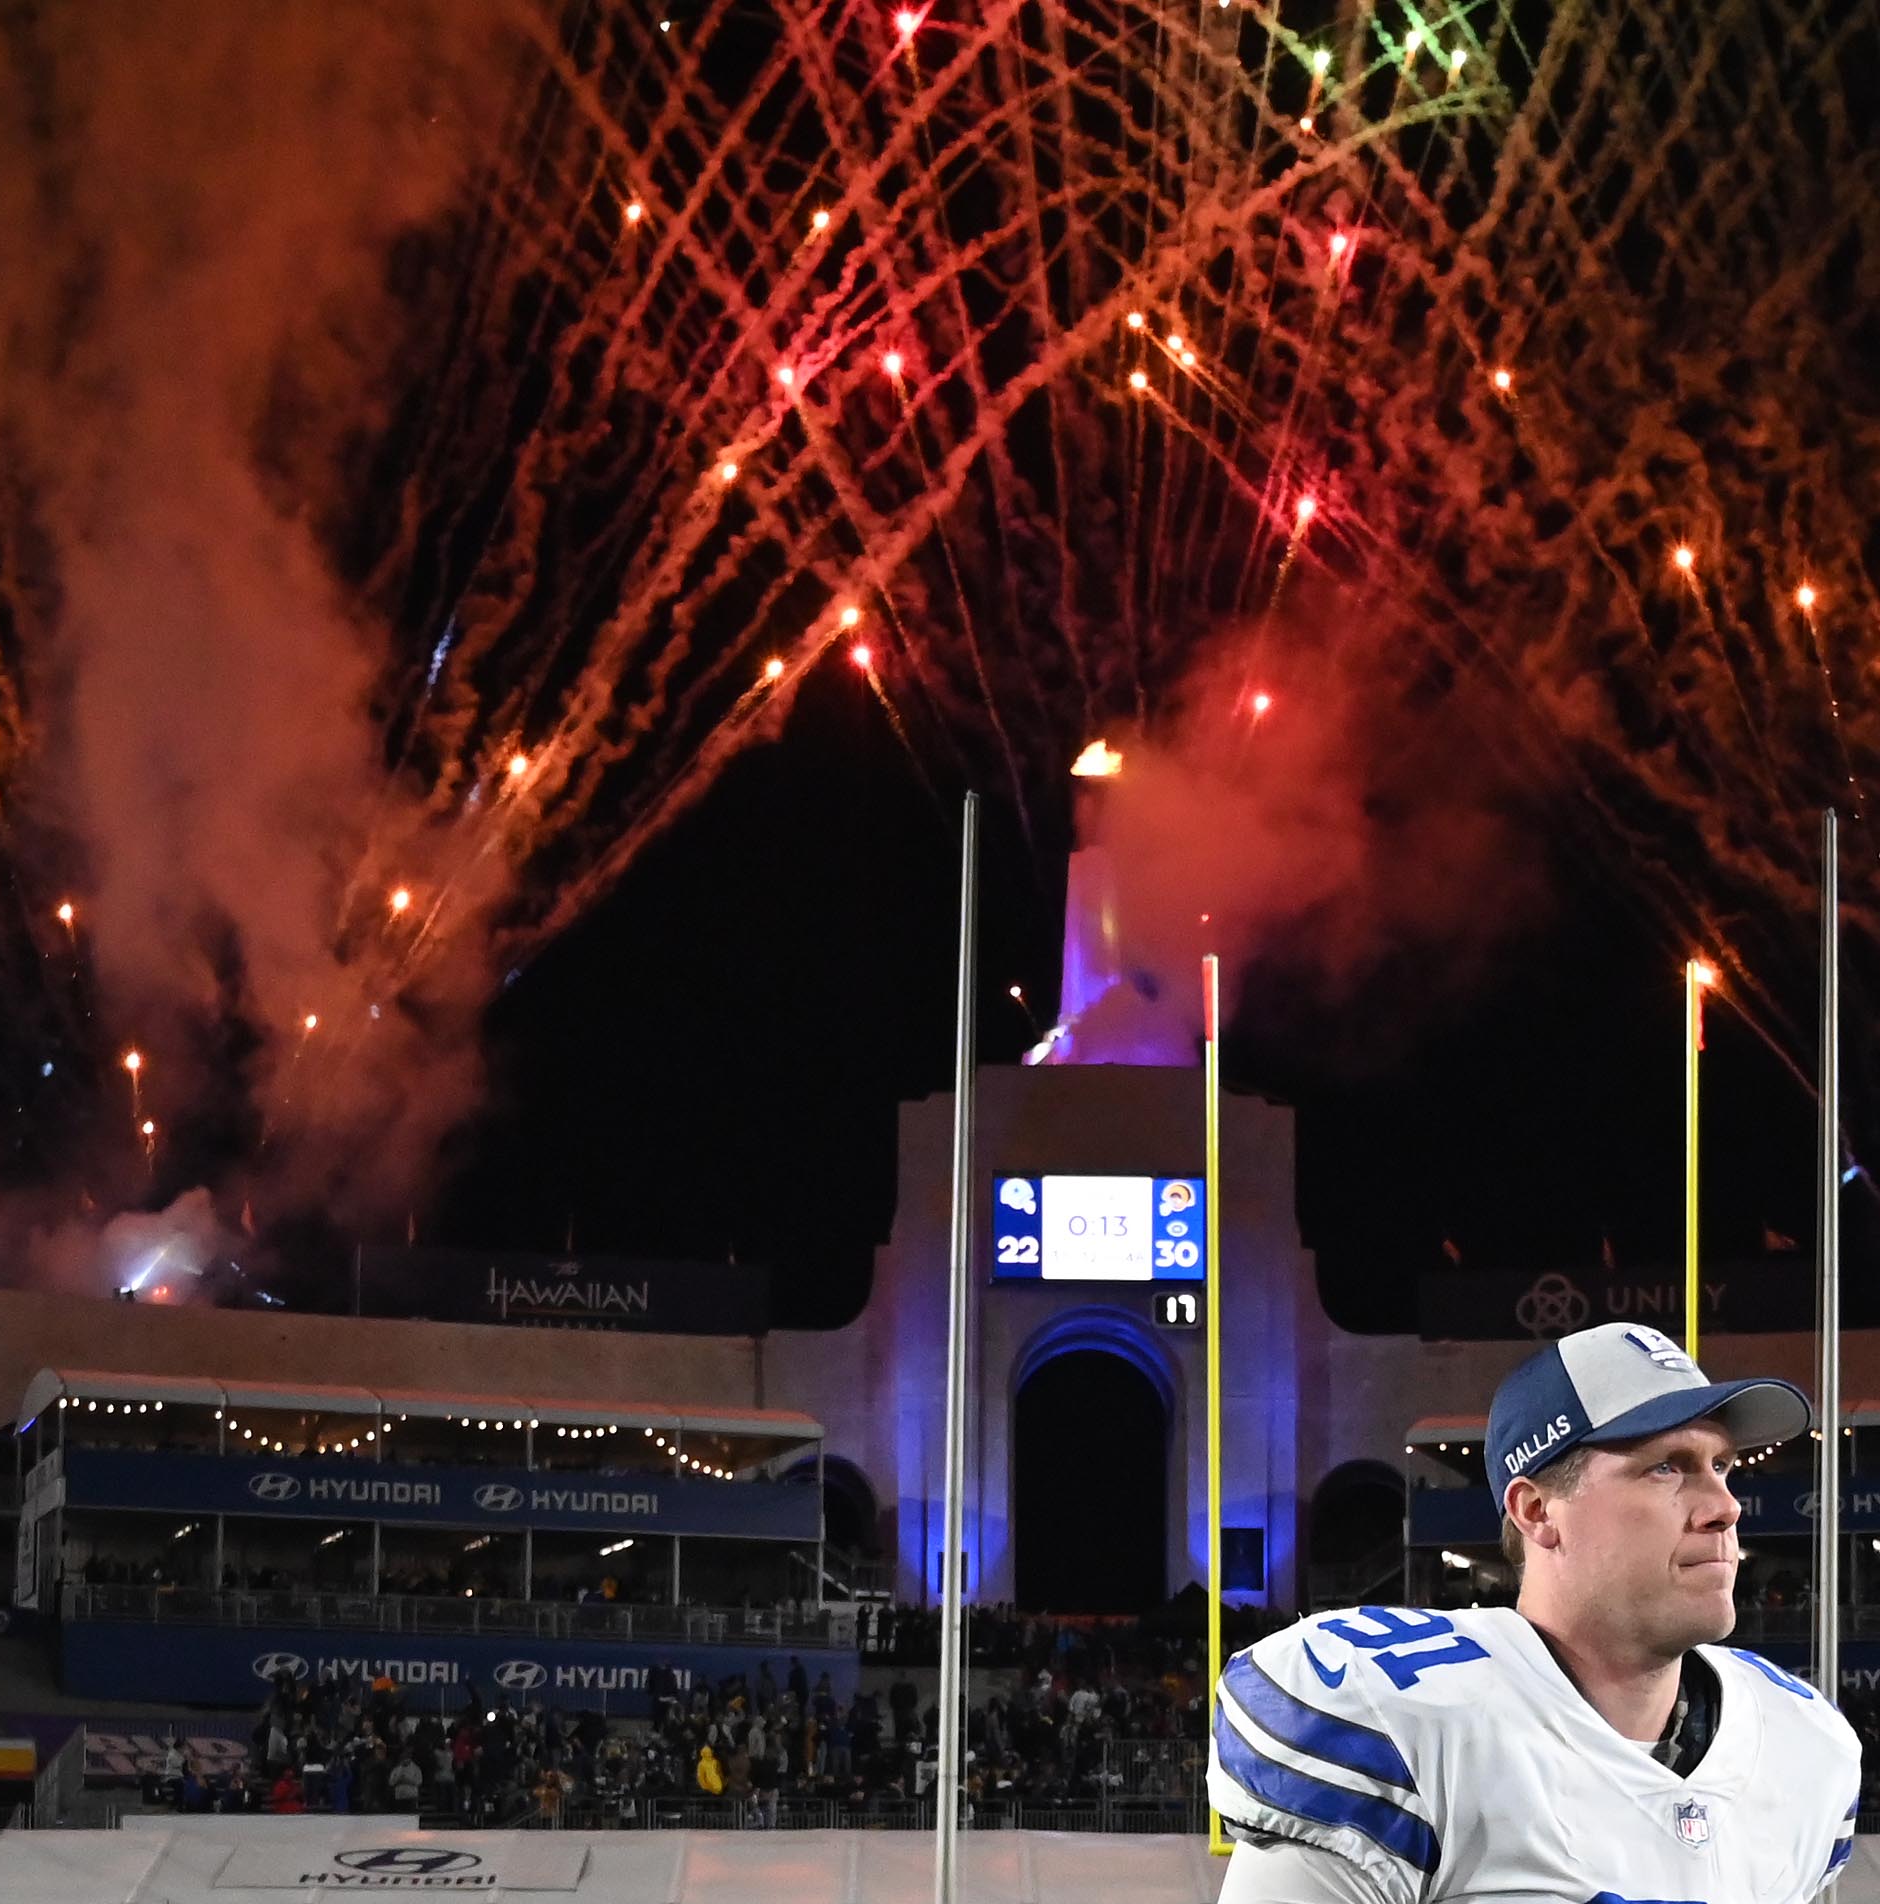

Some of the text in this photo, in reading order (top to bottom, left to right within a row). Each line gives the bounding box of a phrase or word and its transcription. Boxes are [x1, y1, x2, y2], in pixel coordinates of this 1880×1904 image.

[1068, 1215, 1129, 1237] 0:13
[997, 1235, 1040, 1264] 22
[1155, 1240, 1199, 1268] 30
[486, 1266, 649, 1320] HAWAIIAN
[1607, 1281, 1728, 1314] UNIY
[1504, 1414, 1573, 1477] DALLAS
[308, 1478, 442, 1506] HYUNDAI
[531, 1489, 660, 1515] HYUNDAI
[555, 1663, 692, 1692] HYUNI
[298, 1872, 497, 1885] HYUNDAI
